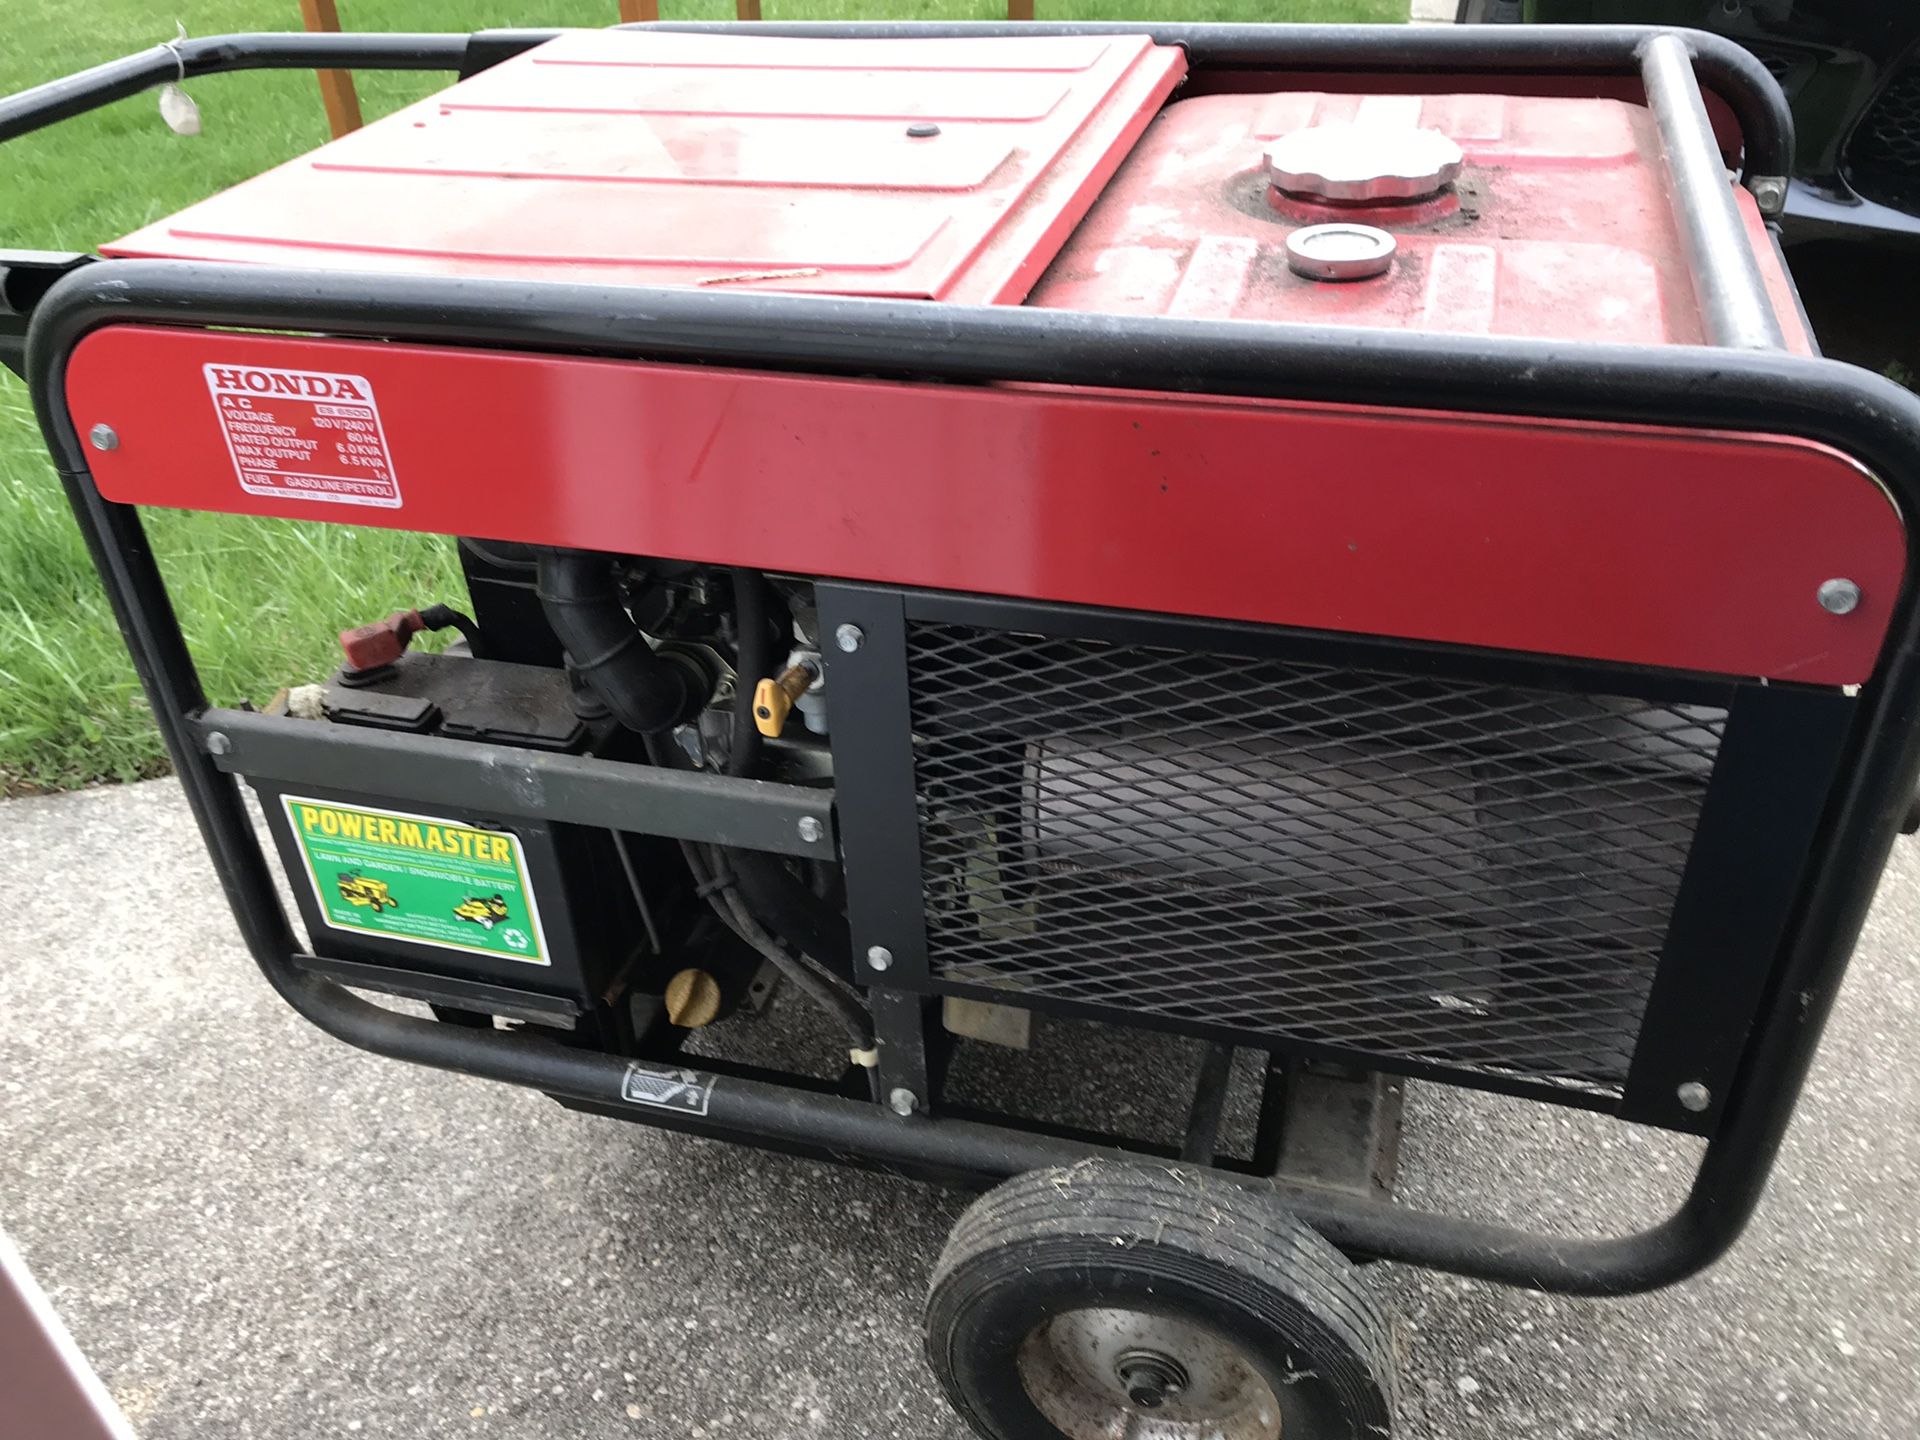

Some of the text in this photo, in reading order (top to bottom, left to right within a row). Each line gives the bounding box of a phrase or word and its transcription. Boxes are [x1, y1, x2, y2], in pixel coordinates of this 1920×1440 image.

[211, 368, 367, 401] HONDA
[222, 409, 276, 424] VOLTAGE
[227, 421, 297, 437] FREQUENCY
[231, 433, 319, 451] RATED OUTPUT
[234, 444, 311, 462] MAX OUTPUT
[238, 456, 279, 470] PHASE
[242, 473, 275, 486] FUEL
[301, 806, 511, 865] POWERMASTER
[314, 852, 342, 864] LAWN
[342, 855, 362, 867] AND
[362, 859, 404, 874] GARDEN
[409, 867, 473, 886] SNOWMOBILE
[472, 878, 516, 893] BATTERY
